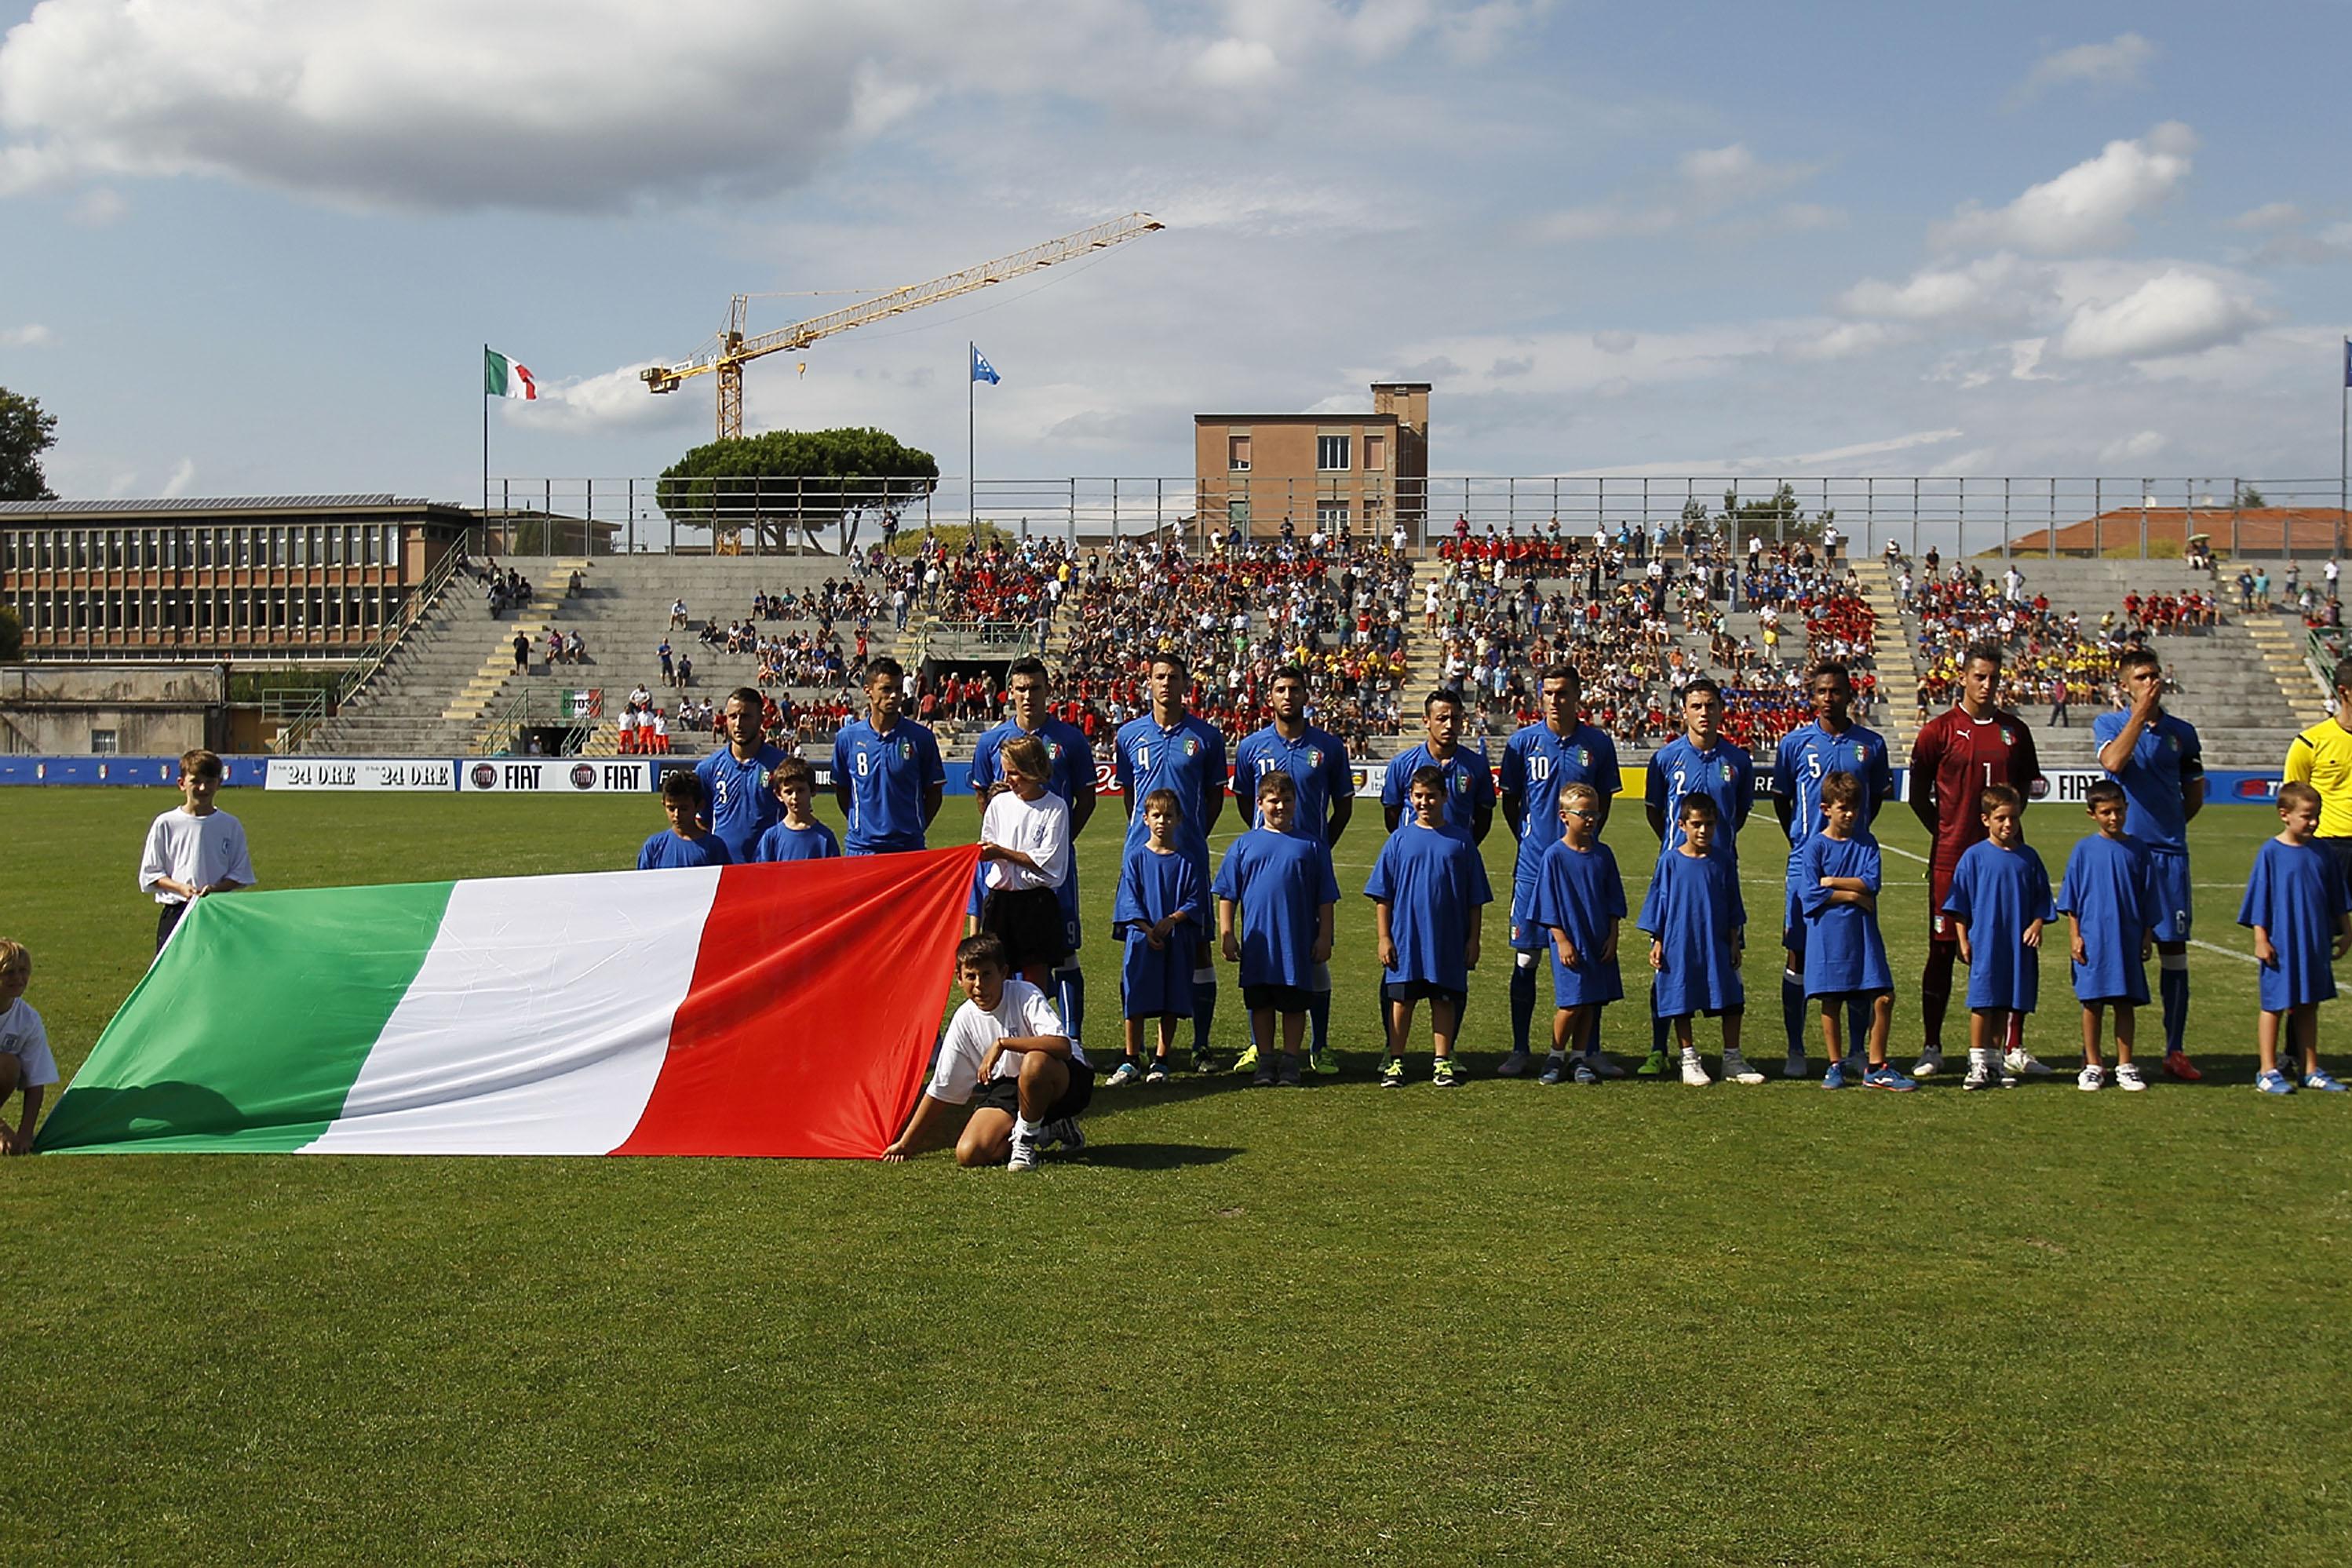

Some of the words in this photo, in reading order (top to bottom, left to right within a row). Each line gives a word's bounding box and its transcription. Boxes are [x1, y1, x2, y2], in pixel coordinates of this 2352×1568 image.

[857, 752, 869, 777] 8
[1138, 746, 1150, 771] 4
[1527, 756, 1549, 782] 10
[1807, 753, 1821, 779] 5
[288, 765, 312, 785] 24
[316, 765, 356, 786] ORE
[381, 765, 405, 786] 24
[409, 766, 449, 786] ORE
[505, 765, 542, 789] FIAT
[604, 765, 642, 790] FIAT
[1674, 771, 1687, 795] 2
[1982, 762, 1991, 787] 1
[716, 780, 727, 804] 3
[2059, 775, 2099, 800] FIAT
[1067, 921, 1076, 945] 9
[2175, 910, 2186, 934] 6
